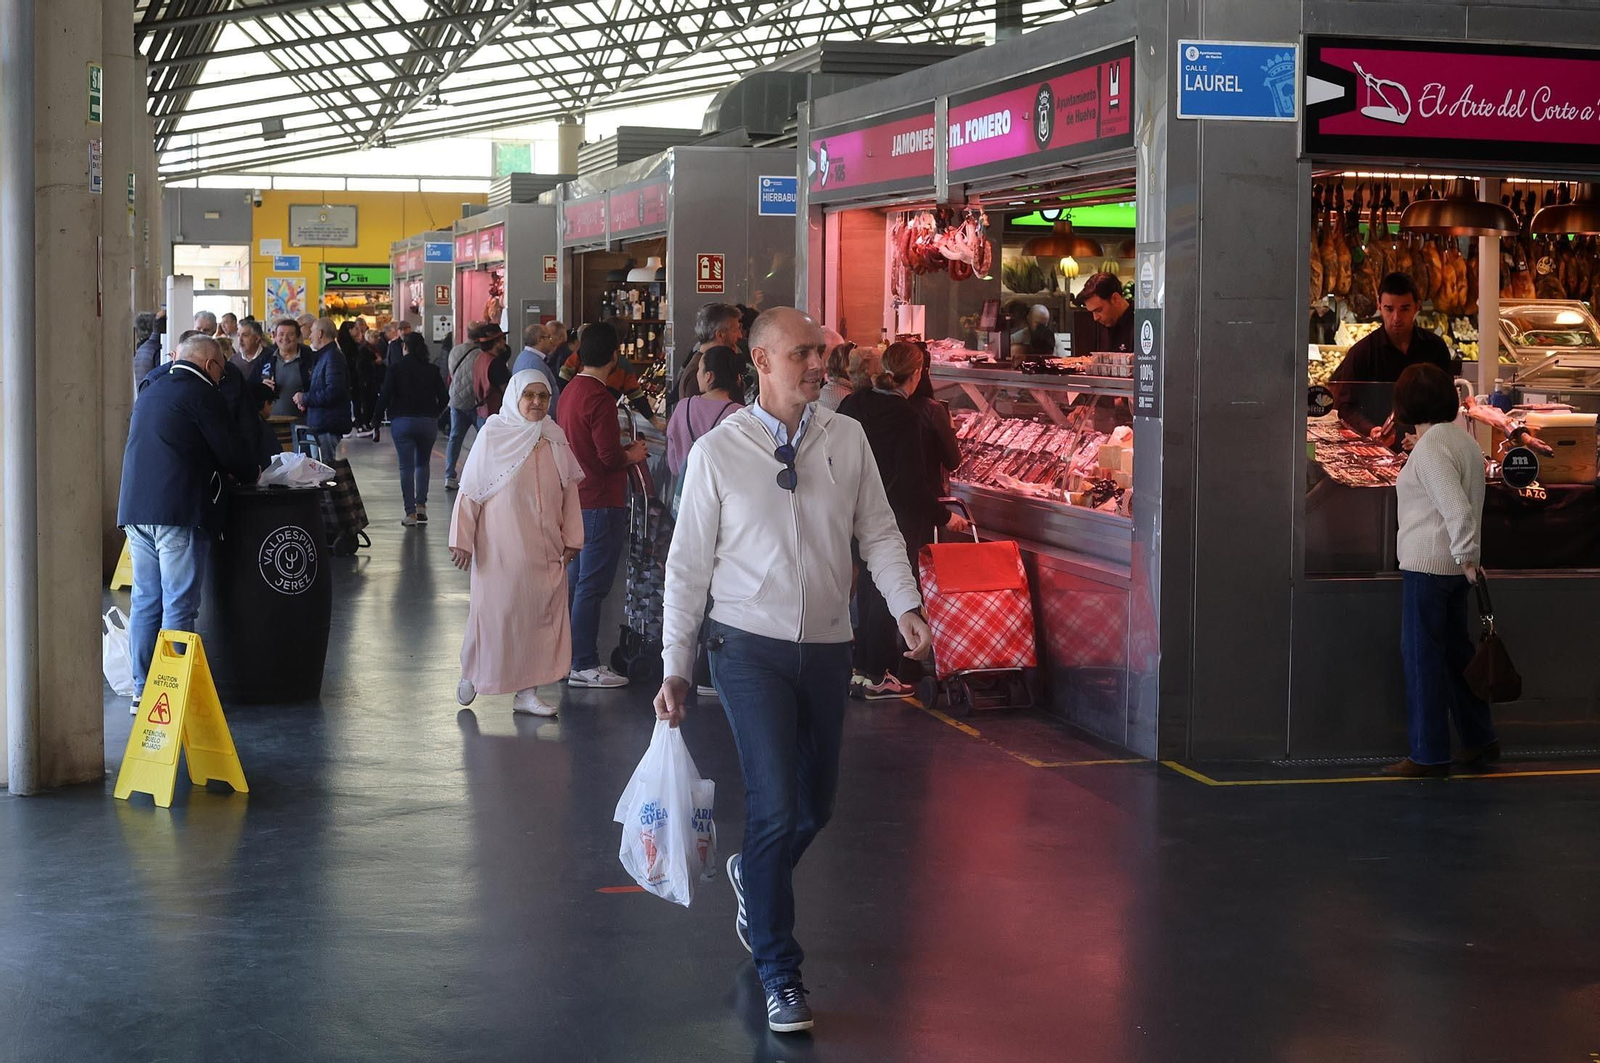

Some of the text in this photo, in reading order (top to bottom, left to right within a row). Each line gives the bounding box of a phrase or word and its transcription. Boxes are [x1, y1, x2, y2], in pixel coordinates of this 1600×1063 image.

[1185, 74, 1243, 92] LAUREL
[1057, 89, 1096, 111] Ayuntamiento
[1418, 83, 1447, 118] El
[1449, 84, 1495, 118] Arte
[1497, 89, 1527, 119] del
[1531, 85, 1579, 122] Corte
[1580, 105, 1594, 121] a
[1066, 112, 1074, 125] de
[1075, 107, 1096, 124] Huelva
[891, 127, 935, 157] JAMONES
[1139, 364, 1154, 381] 100%
[1518, 489, 1547, 500] LAZO
[263, 530, 315, 566] VALDESPINO
[275, 573, 311, 590] JEREZ
[157, 674, 178, 683] CAUTION
[163, 681, 179, 690] FLOOR
[142, 728, 166, 739] ATENCIÓN
[145, 735, 161, 744] SUELO
[141, 741, 161, 751] MOJADO
